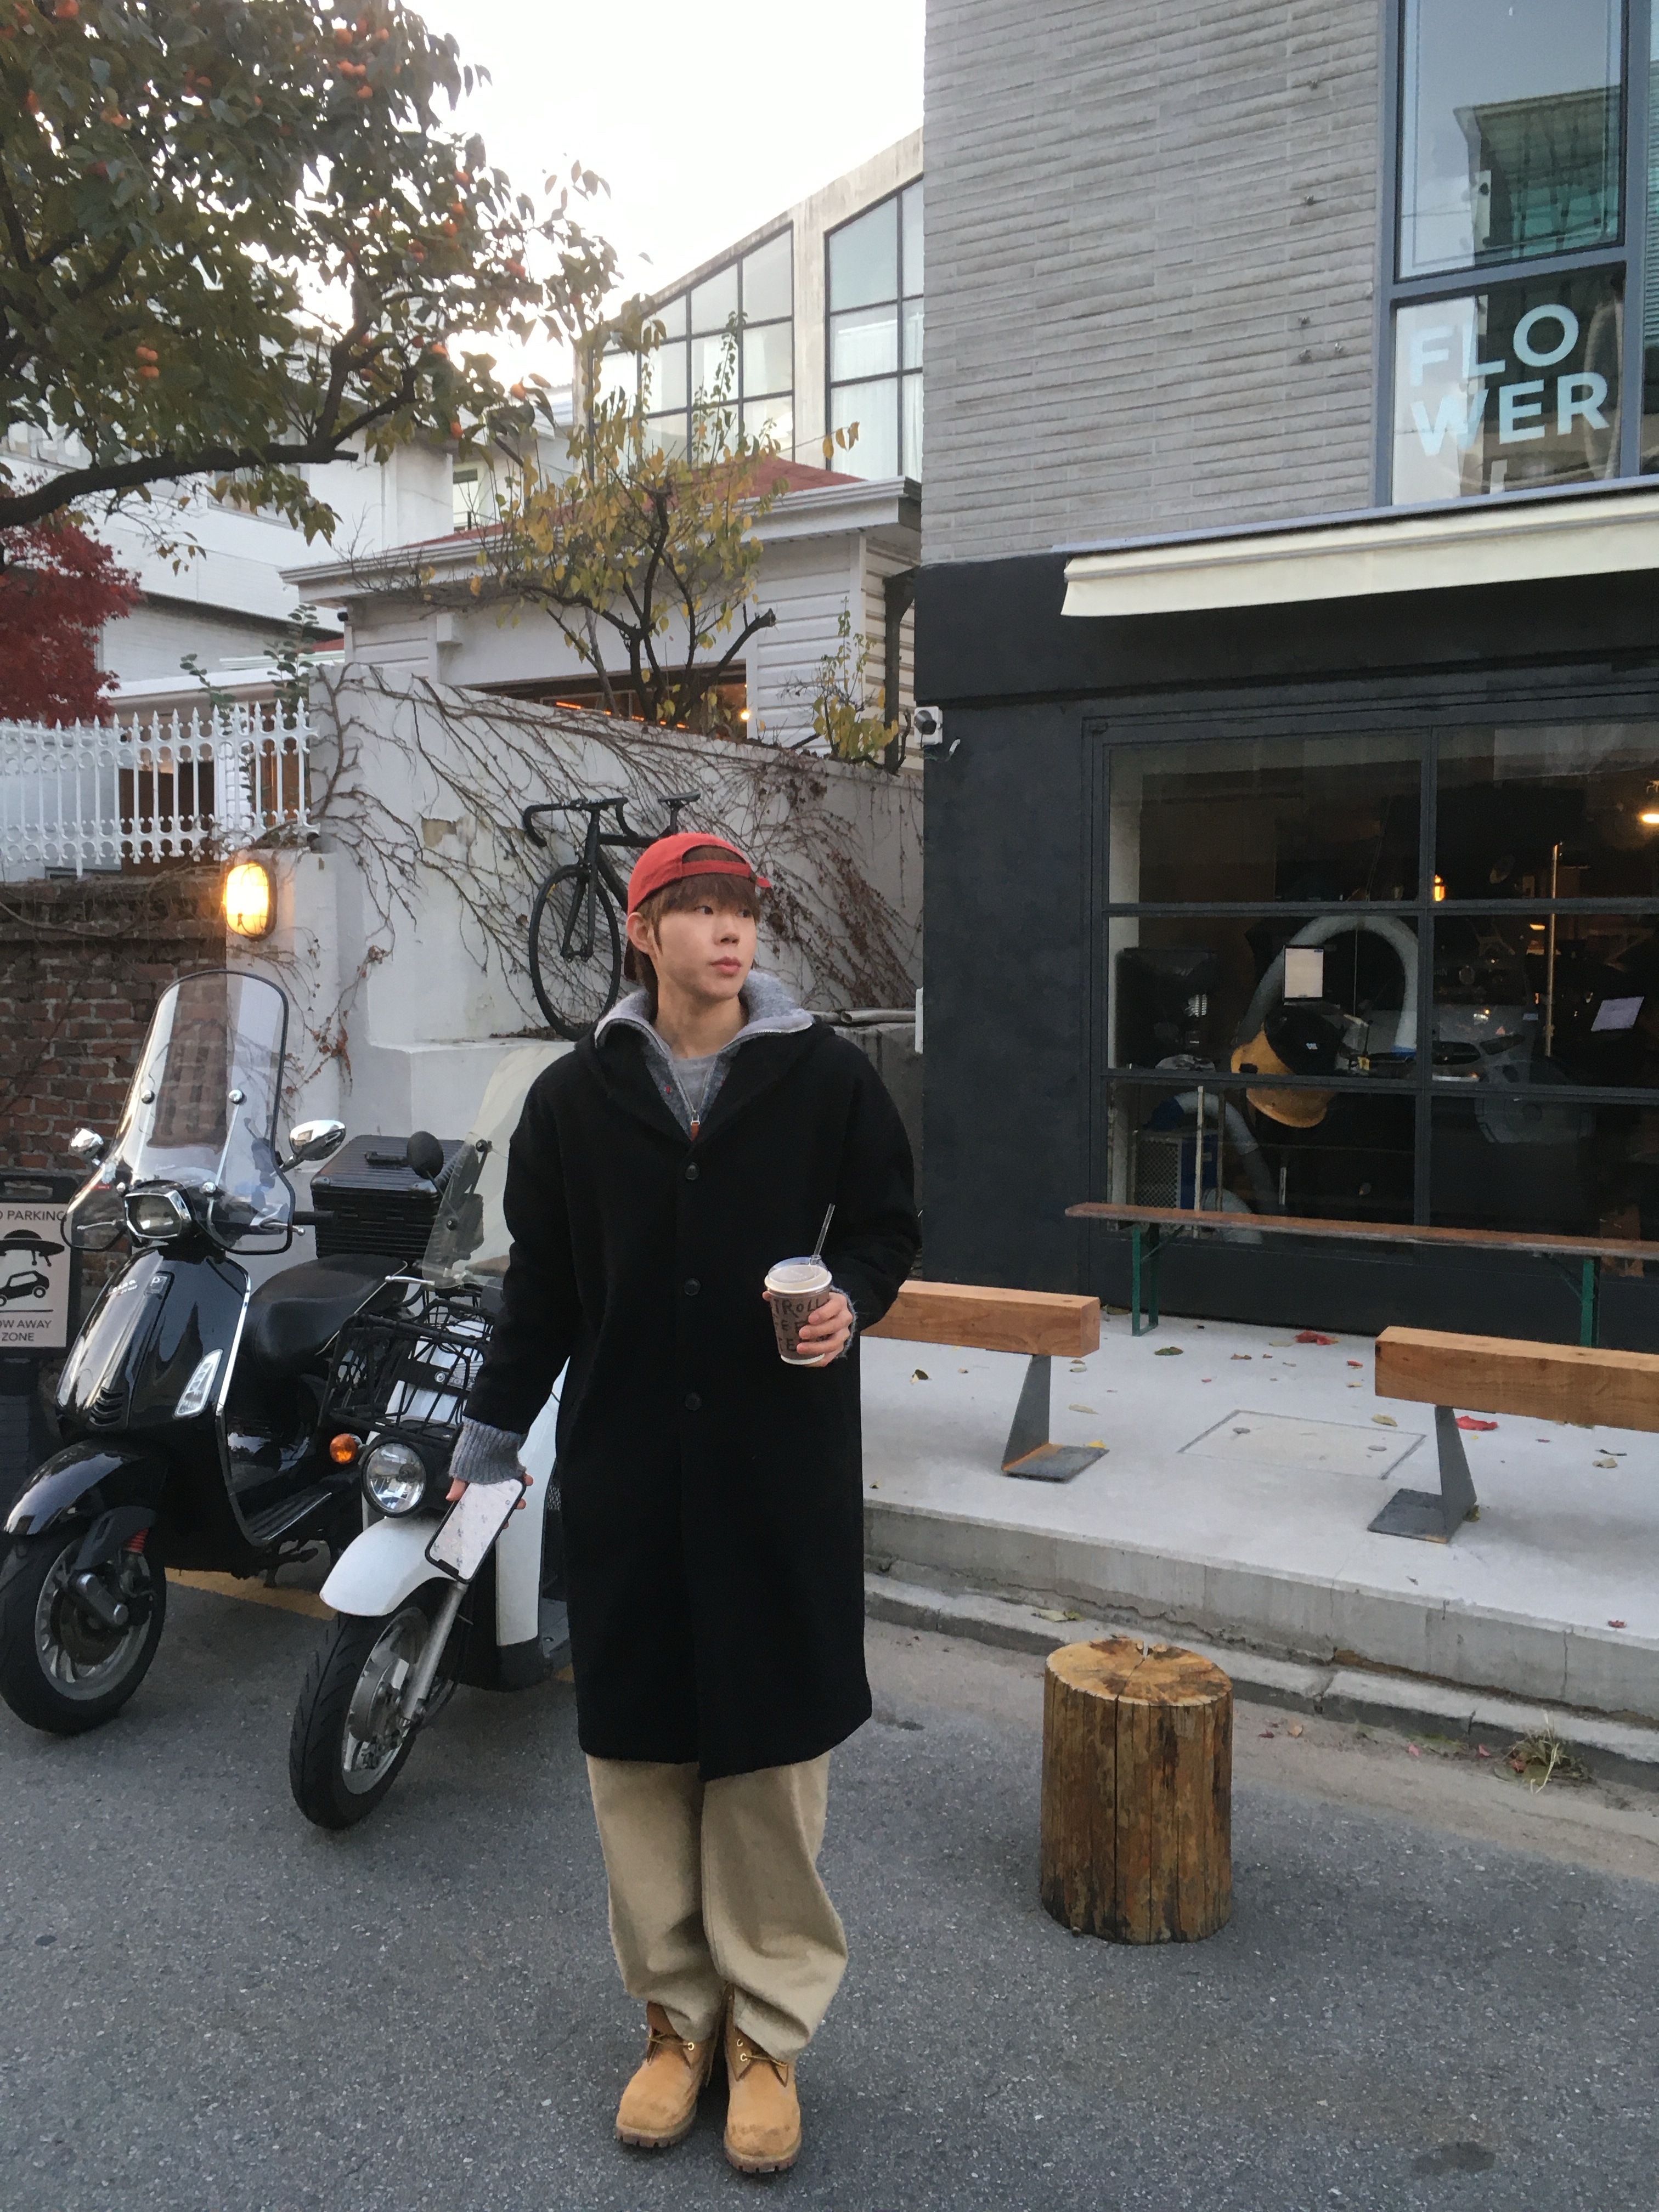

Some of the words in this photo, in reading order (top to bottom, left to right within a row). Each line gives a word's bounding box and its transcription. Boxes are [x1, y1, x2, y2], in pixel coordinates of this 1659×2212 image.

[1409, 303, 1579, 387] FLO
[1410, 371, 1610, 456] WER
[7, 1210, 65, 1221] PARKING
[16, 1320, 52, 1328] AWAY
[2, 1332, 35, 1342] ZONE
